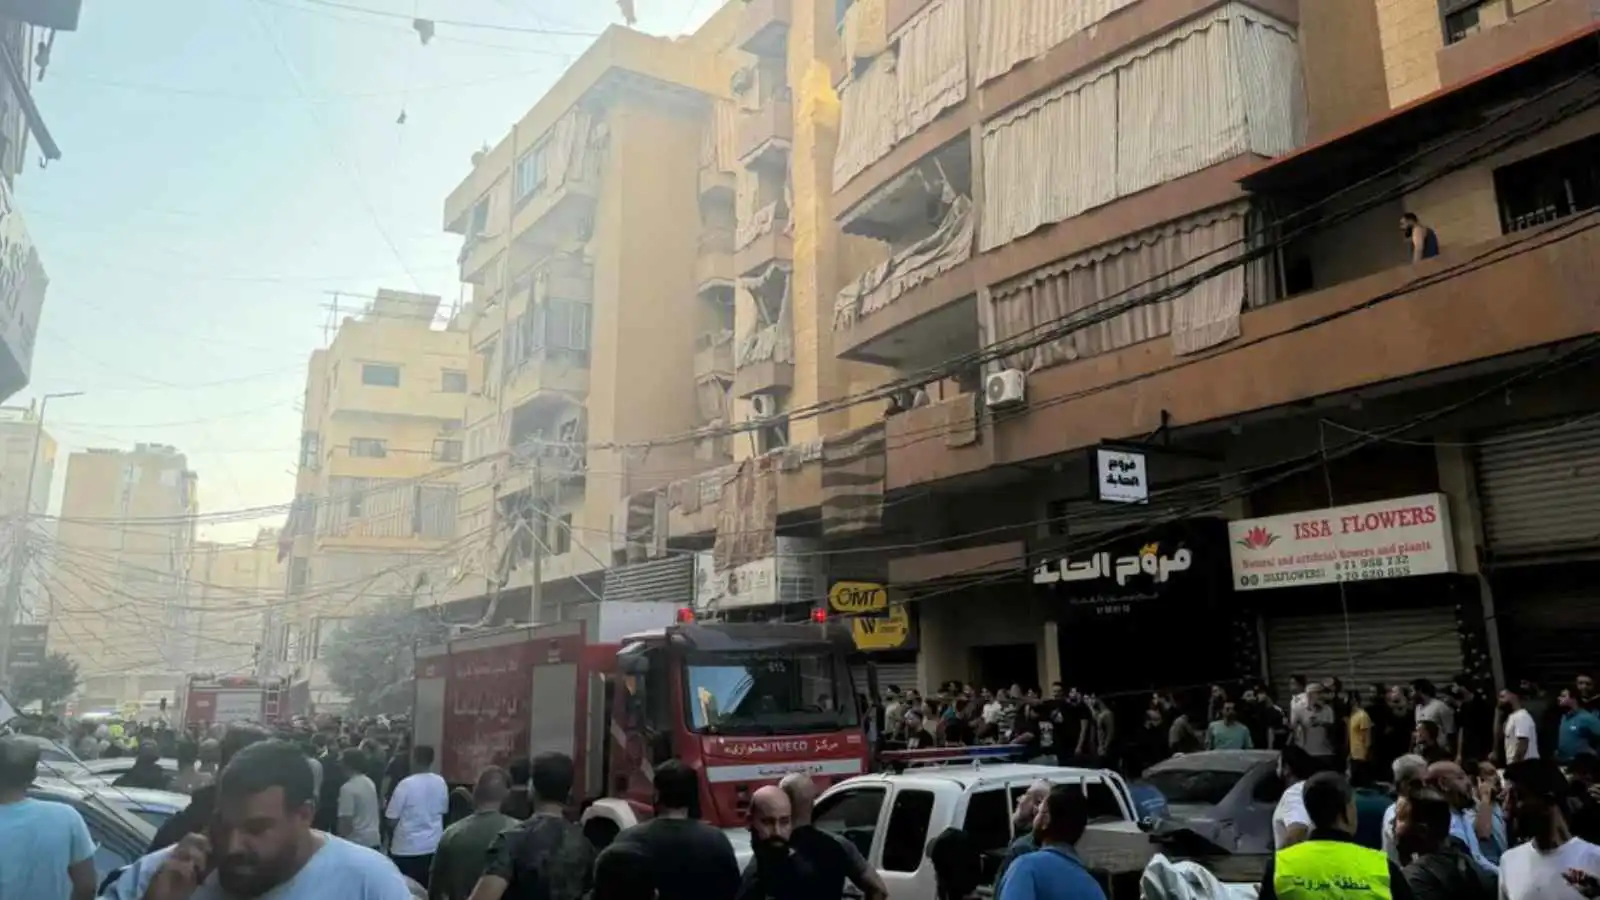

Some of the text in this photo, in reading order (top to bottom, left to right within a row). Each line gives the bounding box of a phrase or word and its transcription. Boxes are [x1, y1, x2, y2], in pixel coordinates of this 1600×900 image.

[1293, 505, 1437, 540] ISSA FLOWERS
[1242, 557, 1275, 569] Natural
[1278, 555, 1294, 567] and
[1377, 542, 1397, 556] and
[836, 587, 880, 607] OMT
[770, 740, 808, 752] IVECO
